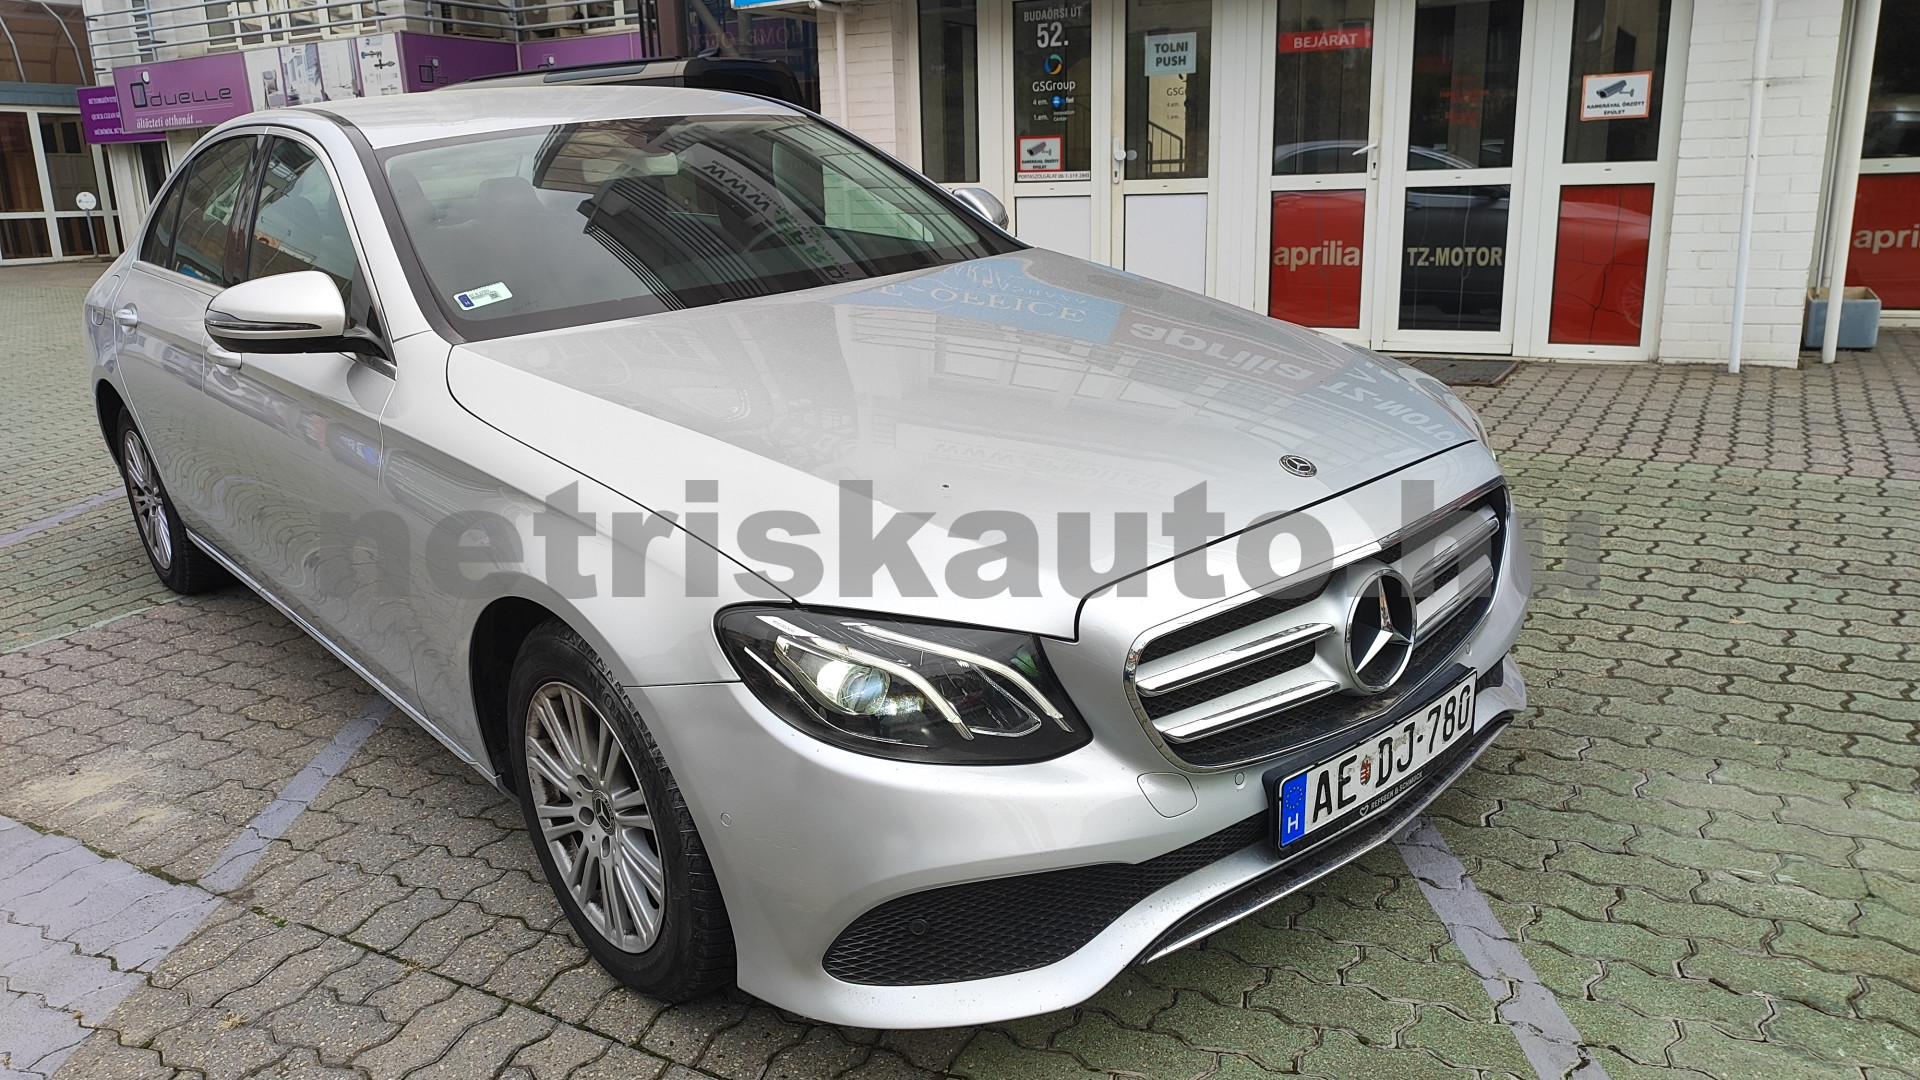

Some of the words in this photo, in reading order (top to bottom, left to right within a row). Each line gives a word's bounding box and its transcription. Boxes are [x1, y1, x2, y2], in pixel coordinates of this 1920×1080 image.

[1023, 6, 1068, 22] BUDAÖRSI
[1070, 3, 1082, 17] ÚT
[1036, 21, 1069, 48] 52.
[1293, 32, 1358, 49] BEJÁRAT
[1154, 41, 1189, 53] TOLNI
[1155, 55, 1187, 67] PUSH
[1032, 80, 1076, 92] GSGroup
[136, 117, 164, 129] öltözteti
[164, 113, 194, 125] otthonát
[1273, 240, 1360, 271] aprilia
[1406, 246, 1503, 267] TZ-MOTOR
[1287, 812, 1299, 834] H
[1312, 754, 1358, 823] AE
[1375, 684, 1471, 788] DJ-780
